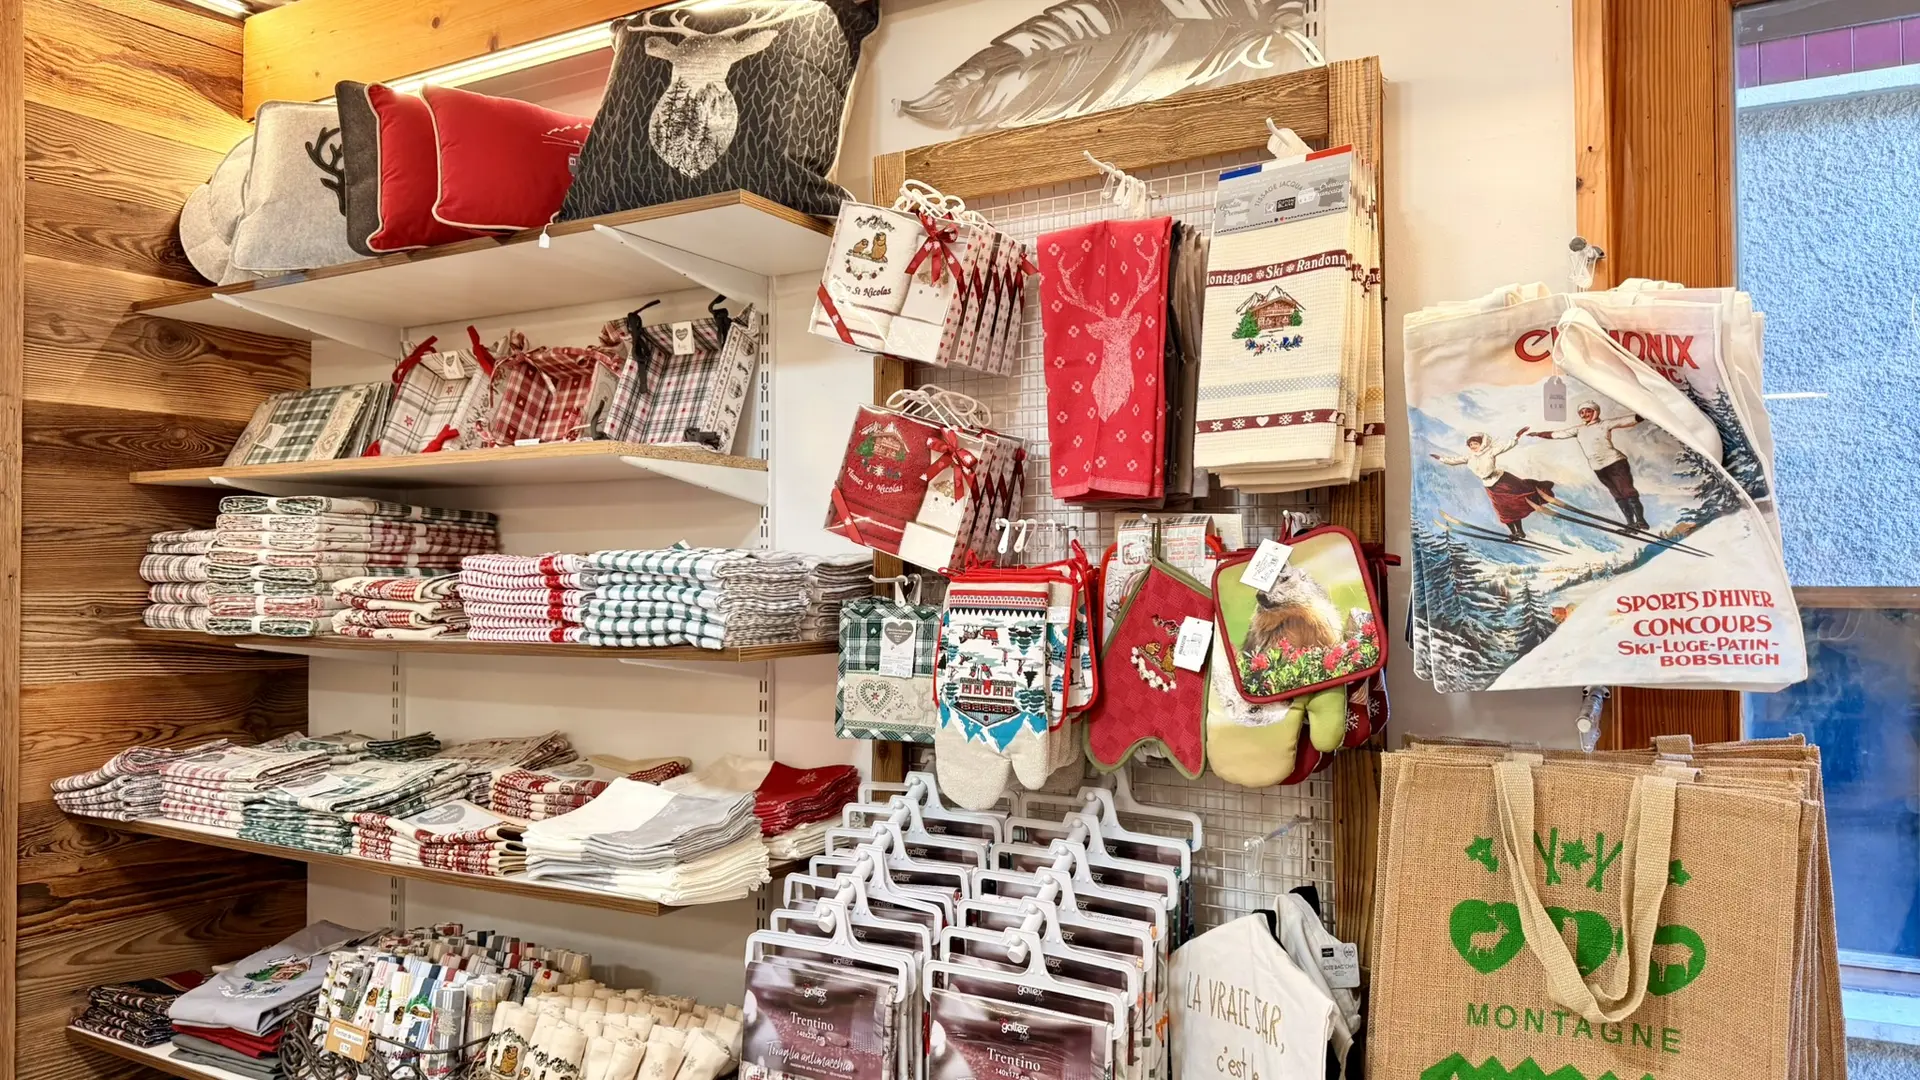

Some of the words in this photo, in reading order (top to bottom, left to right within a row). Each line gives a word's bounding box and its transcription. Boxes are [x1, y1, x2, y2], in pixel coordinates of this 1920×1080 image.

[1254, 184, 1278, 207] TISSAGE
[1265, 263, 1284, 279] Ski
[863, 285, 892, 298] Nicolas
[1514, 326, 1700, 370] CONIX
[1616, 591, 1699, 613] SPORTS
[1703, 589, 1775, 609] D'HIVER
[1633, 614, 1772, 637] CONCOURS
[1660, 653, 1779, 668] BOBSLEIGH
[1186, 971, 1201, 1013] LA
[1208, 978, 1250, 1029] VRAIE
[790, 1011, 834, 1032] Trentino
[1466, 1002, 1682, 1055] MONTAGNE
[987, 1047, 1041, 1072] Trentino
